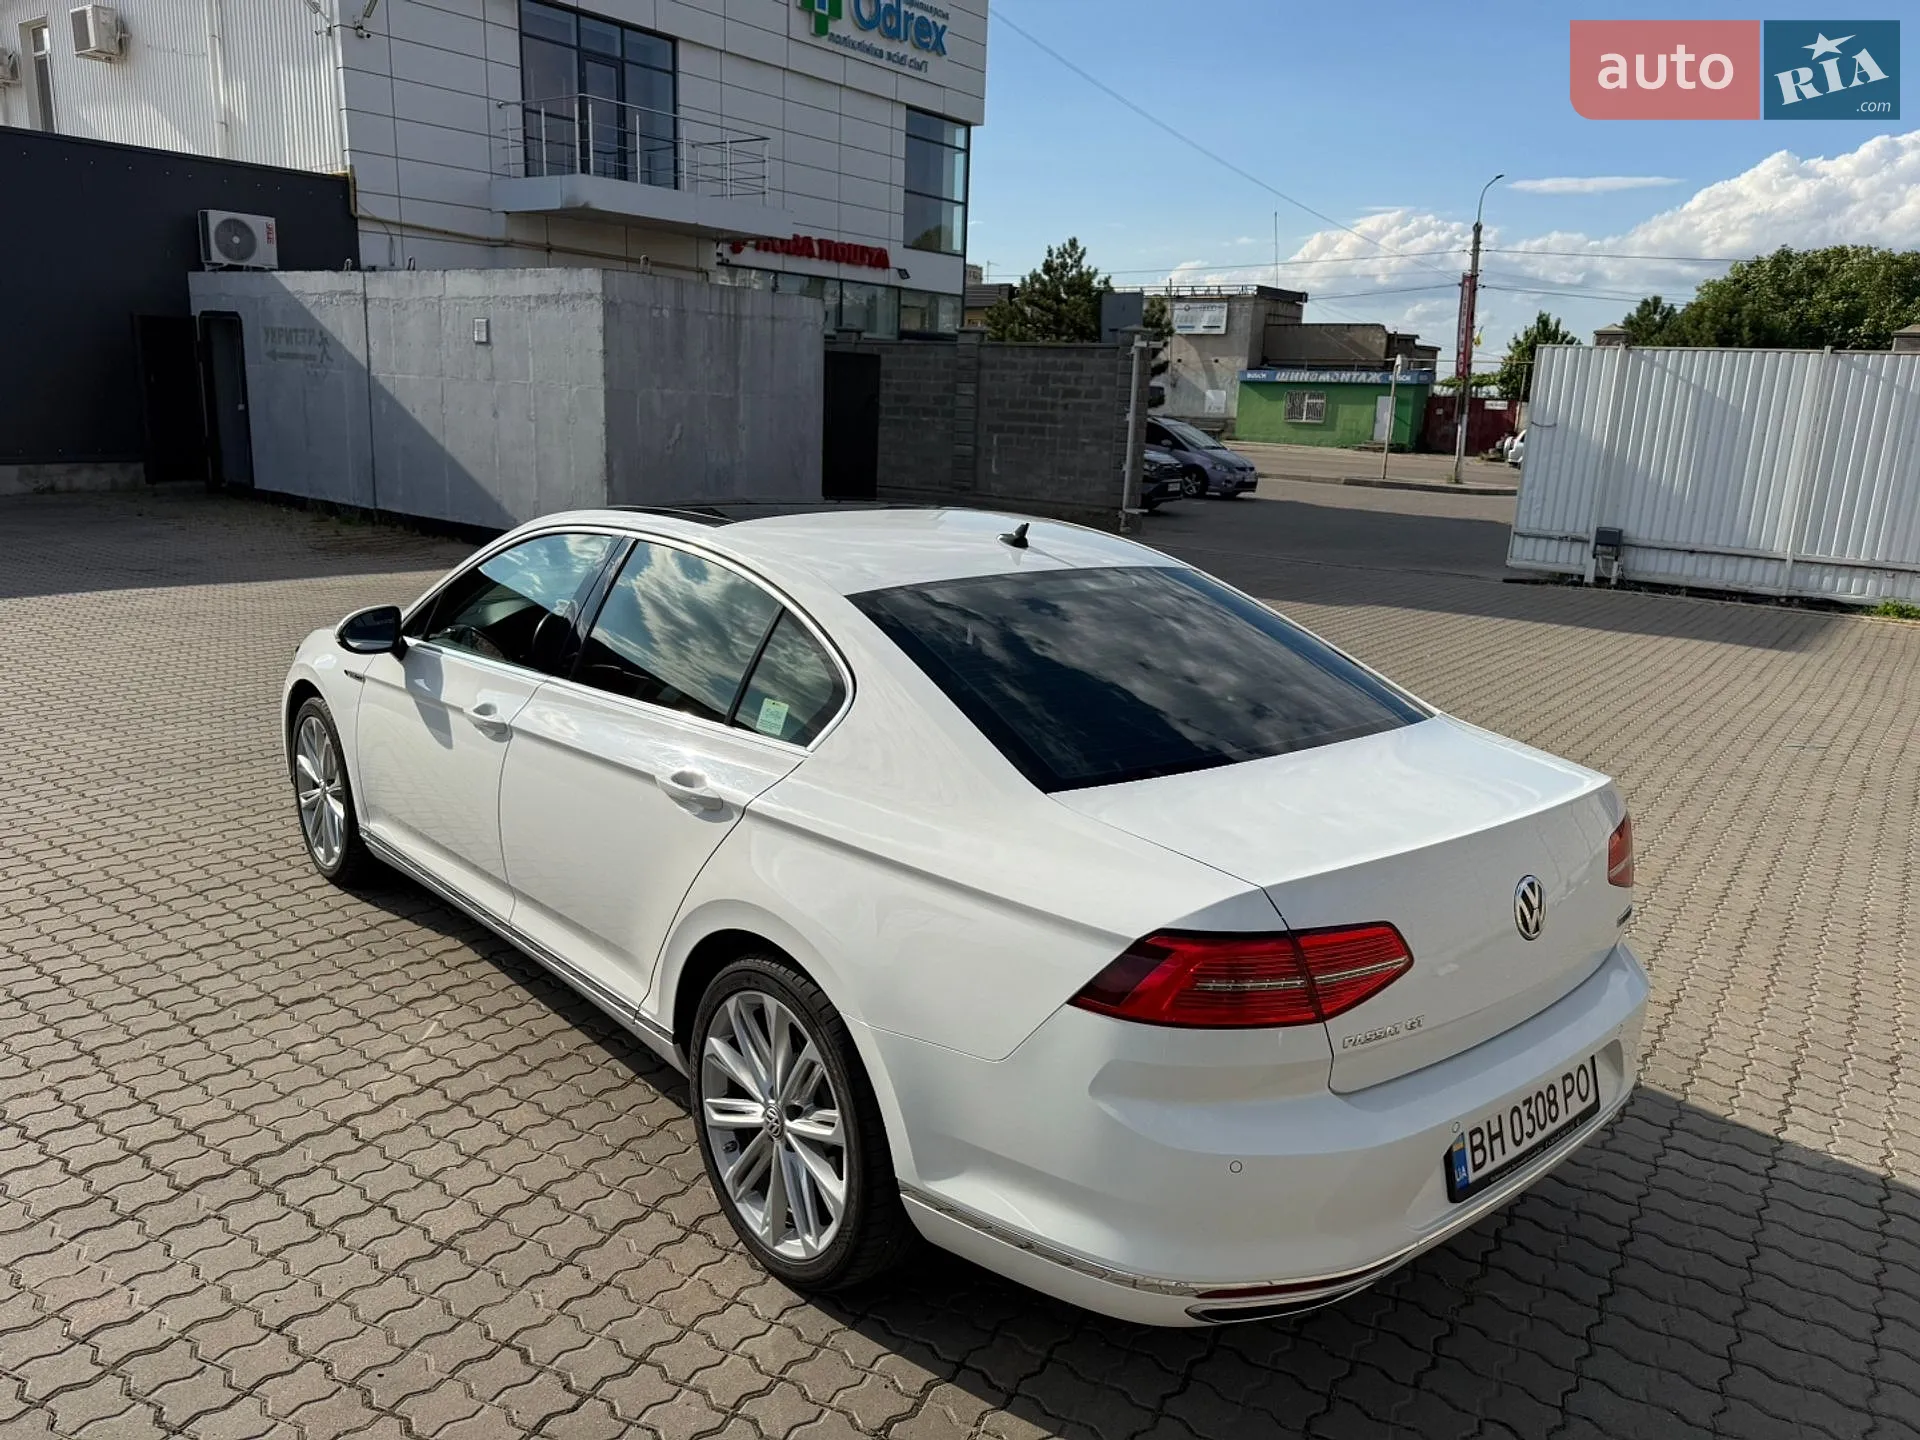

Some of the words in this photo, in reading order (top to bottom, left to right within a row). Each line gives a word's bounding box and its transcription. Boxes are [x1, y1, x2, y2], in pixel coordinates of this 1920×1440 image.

[853, 0, 948, 56] Odrex
[1342, 1022, 1401, 1049] PASSAT
[1469, 1114, 1506, 1173] BH
[1510, 1083, 1560, 1147] 0308
[1562, 1064, 1590, 1115] PO
